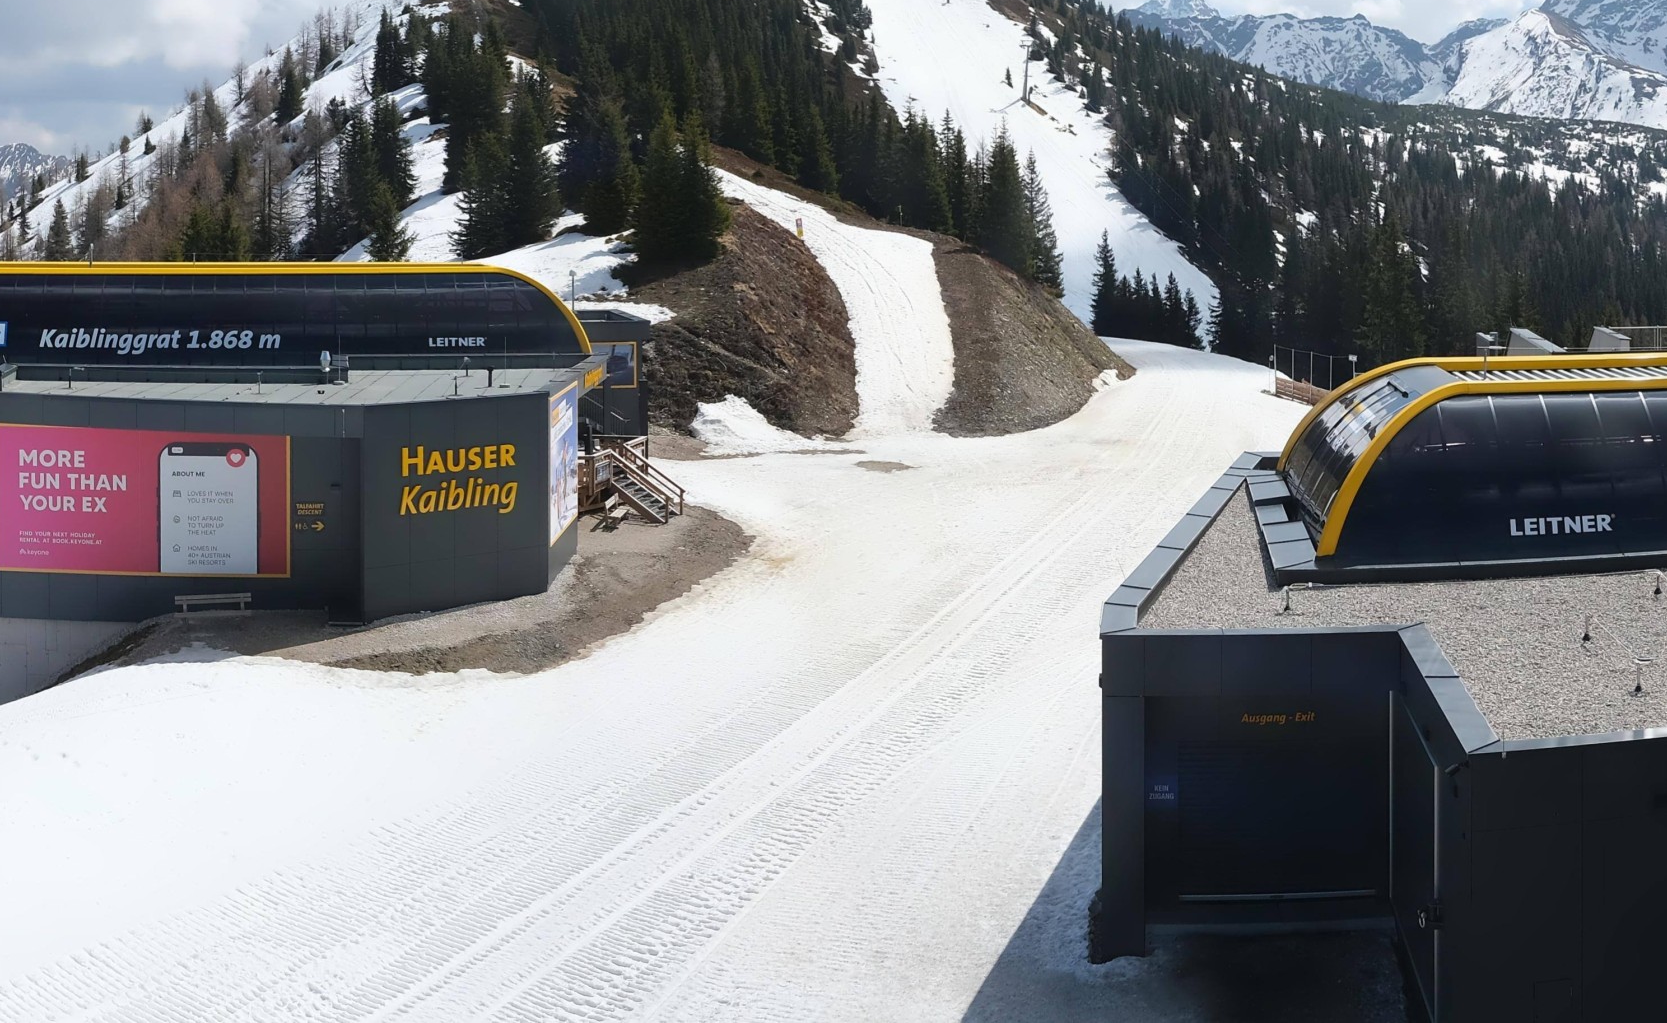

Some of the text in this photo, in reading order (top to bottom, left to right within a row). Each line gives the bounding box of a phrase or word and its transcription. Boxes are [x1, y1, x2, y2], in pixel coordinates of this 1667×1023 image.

[39, 328, 281, 355] Kaiblinggrat 1.868 m
[18, 449, 85, 468] MORE
[401, 443, 516, 477] HAUSER
[18, 472, 127, 491] FUN THAN
[19, 495, 107, 513] YOUR EX
[400, 477, 518, 515] Kaibling
[1241, 713, 1286, 726] Ausgang
[1295, 711, 1315, 722] Exit
[1149, 792, 1175, 800] ZUGANG
